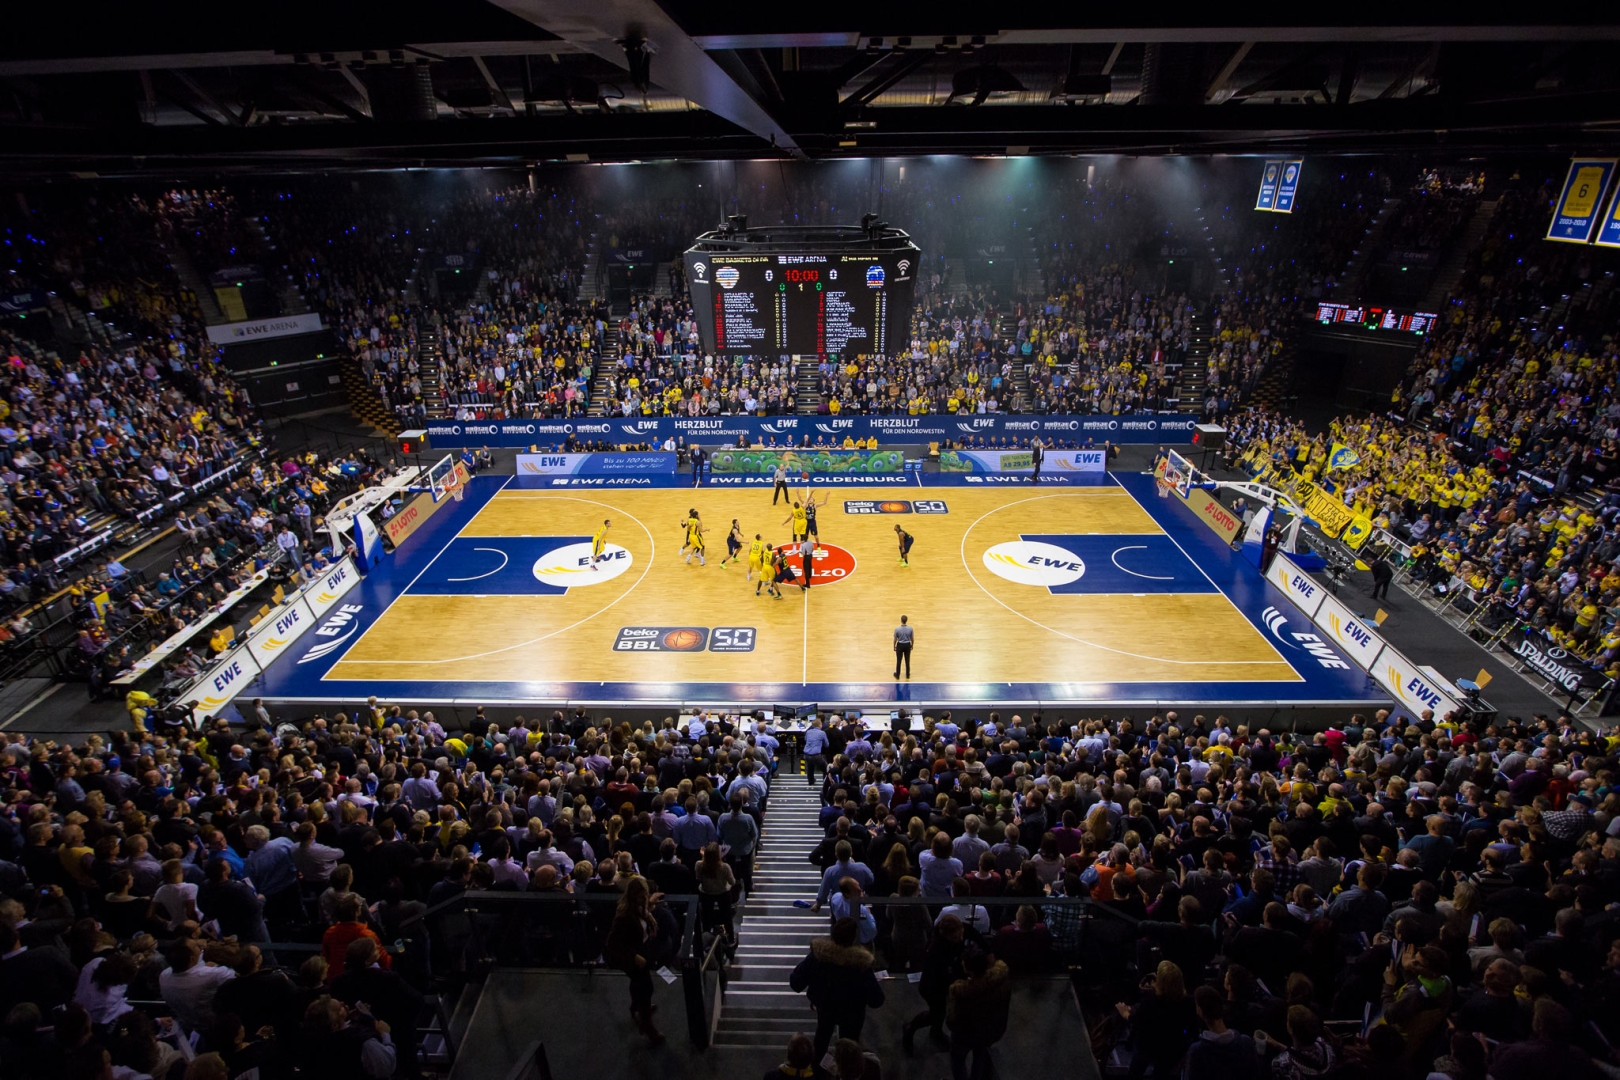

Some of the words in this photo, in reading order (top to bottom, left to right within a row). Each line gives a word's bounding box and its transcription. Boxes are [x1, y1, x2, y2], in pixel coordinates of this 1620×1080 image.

[1578, 184, 1589, 198] 6
[765, 270, 773, 281] 0
[785, 269, 819, 282] 10:00
[830, 269, 837, 279] 0
[780, 283, 785, 291] 0
[816, 282, 822, 290] 0
[246, 325, 269, 335] EWE
[270, 322, 298, 332] ARENA
[638, 421, 658, 429] EWE
[675, 420, 723, 428] HERZBLUT
[870, 419, 919, 427] HERZBLUT
[974, 419, 994, 427] EWE
[403, 443, 410, 453] 2
[541, 457, 566, 466] EWE
[1074, 453, 1101, 463] EWE
[916, 502, 945, 510] 50
[396, 507, 418, 529] LOTTO
[1212, 508, 1235, 532] LOTTO
[578, 550, 626, 566] EWE
[1028, 556, 1082, 571] EWE
[327, 567, 346, 590] EWE
[812, 568, 846, 576] LzO
[1291, 575, 1314, 598] EWE
[276, 609, 300, 635] EWE
[315, 604, 363, 636] EWE
[714, 629, 752, 646] 50
[1344, 621, 1371, 648] EWE
[617, 641, 660, 650] BBL
[1291, 632, 1350, 670] EWE
[1514, 640, 1582, 691] SPALDING
[213, 661, 242, 692] EWE
[1407, 678, 1441, 709] EWE
